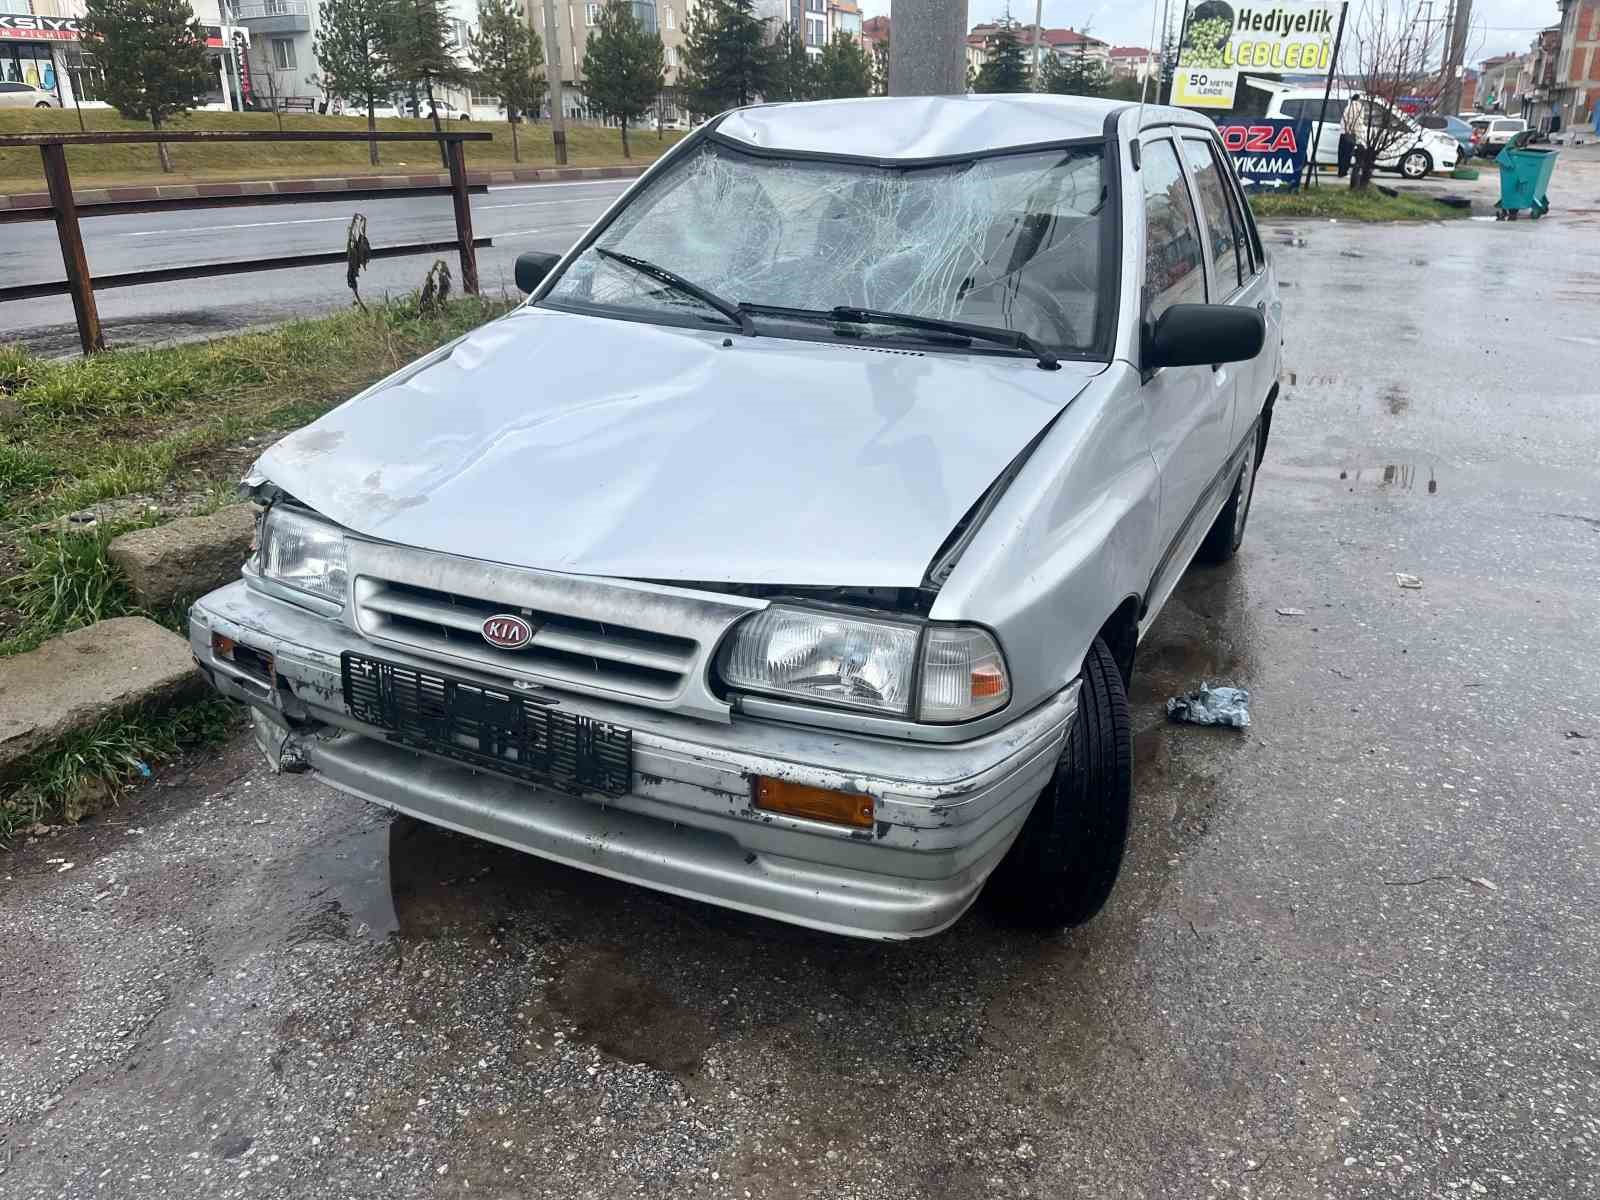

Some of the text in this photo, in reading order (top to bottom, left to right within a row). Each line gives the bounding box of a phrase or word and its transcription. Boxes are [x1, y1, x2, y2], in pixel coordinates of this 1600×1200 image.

[1237, 9, 1333, 37] Hediyelik
[1223, 39, 1329, 67] LEBLEBİ
[1190, 74, 1208, 86] 50
[1233, 157, 1294, 173] YIKAMA
[490, 621, 520, 641] KIA
